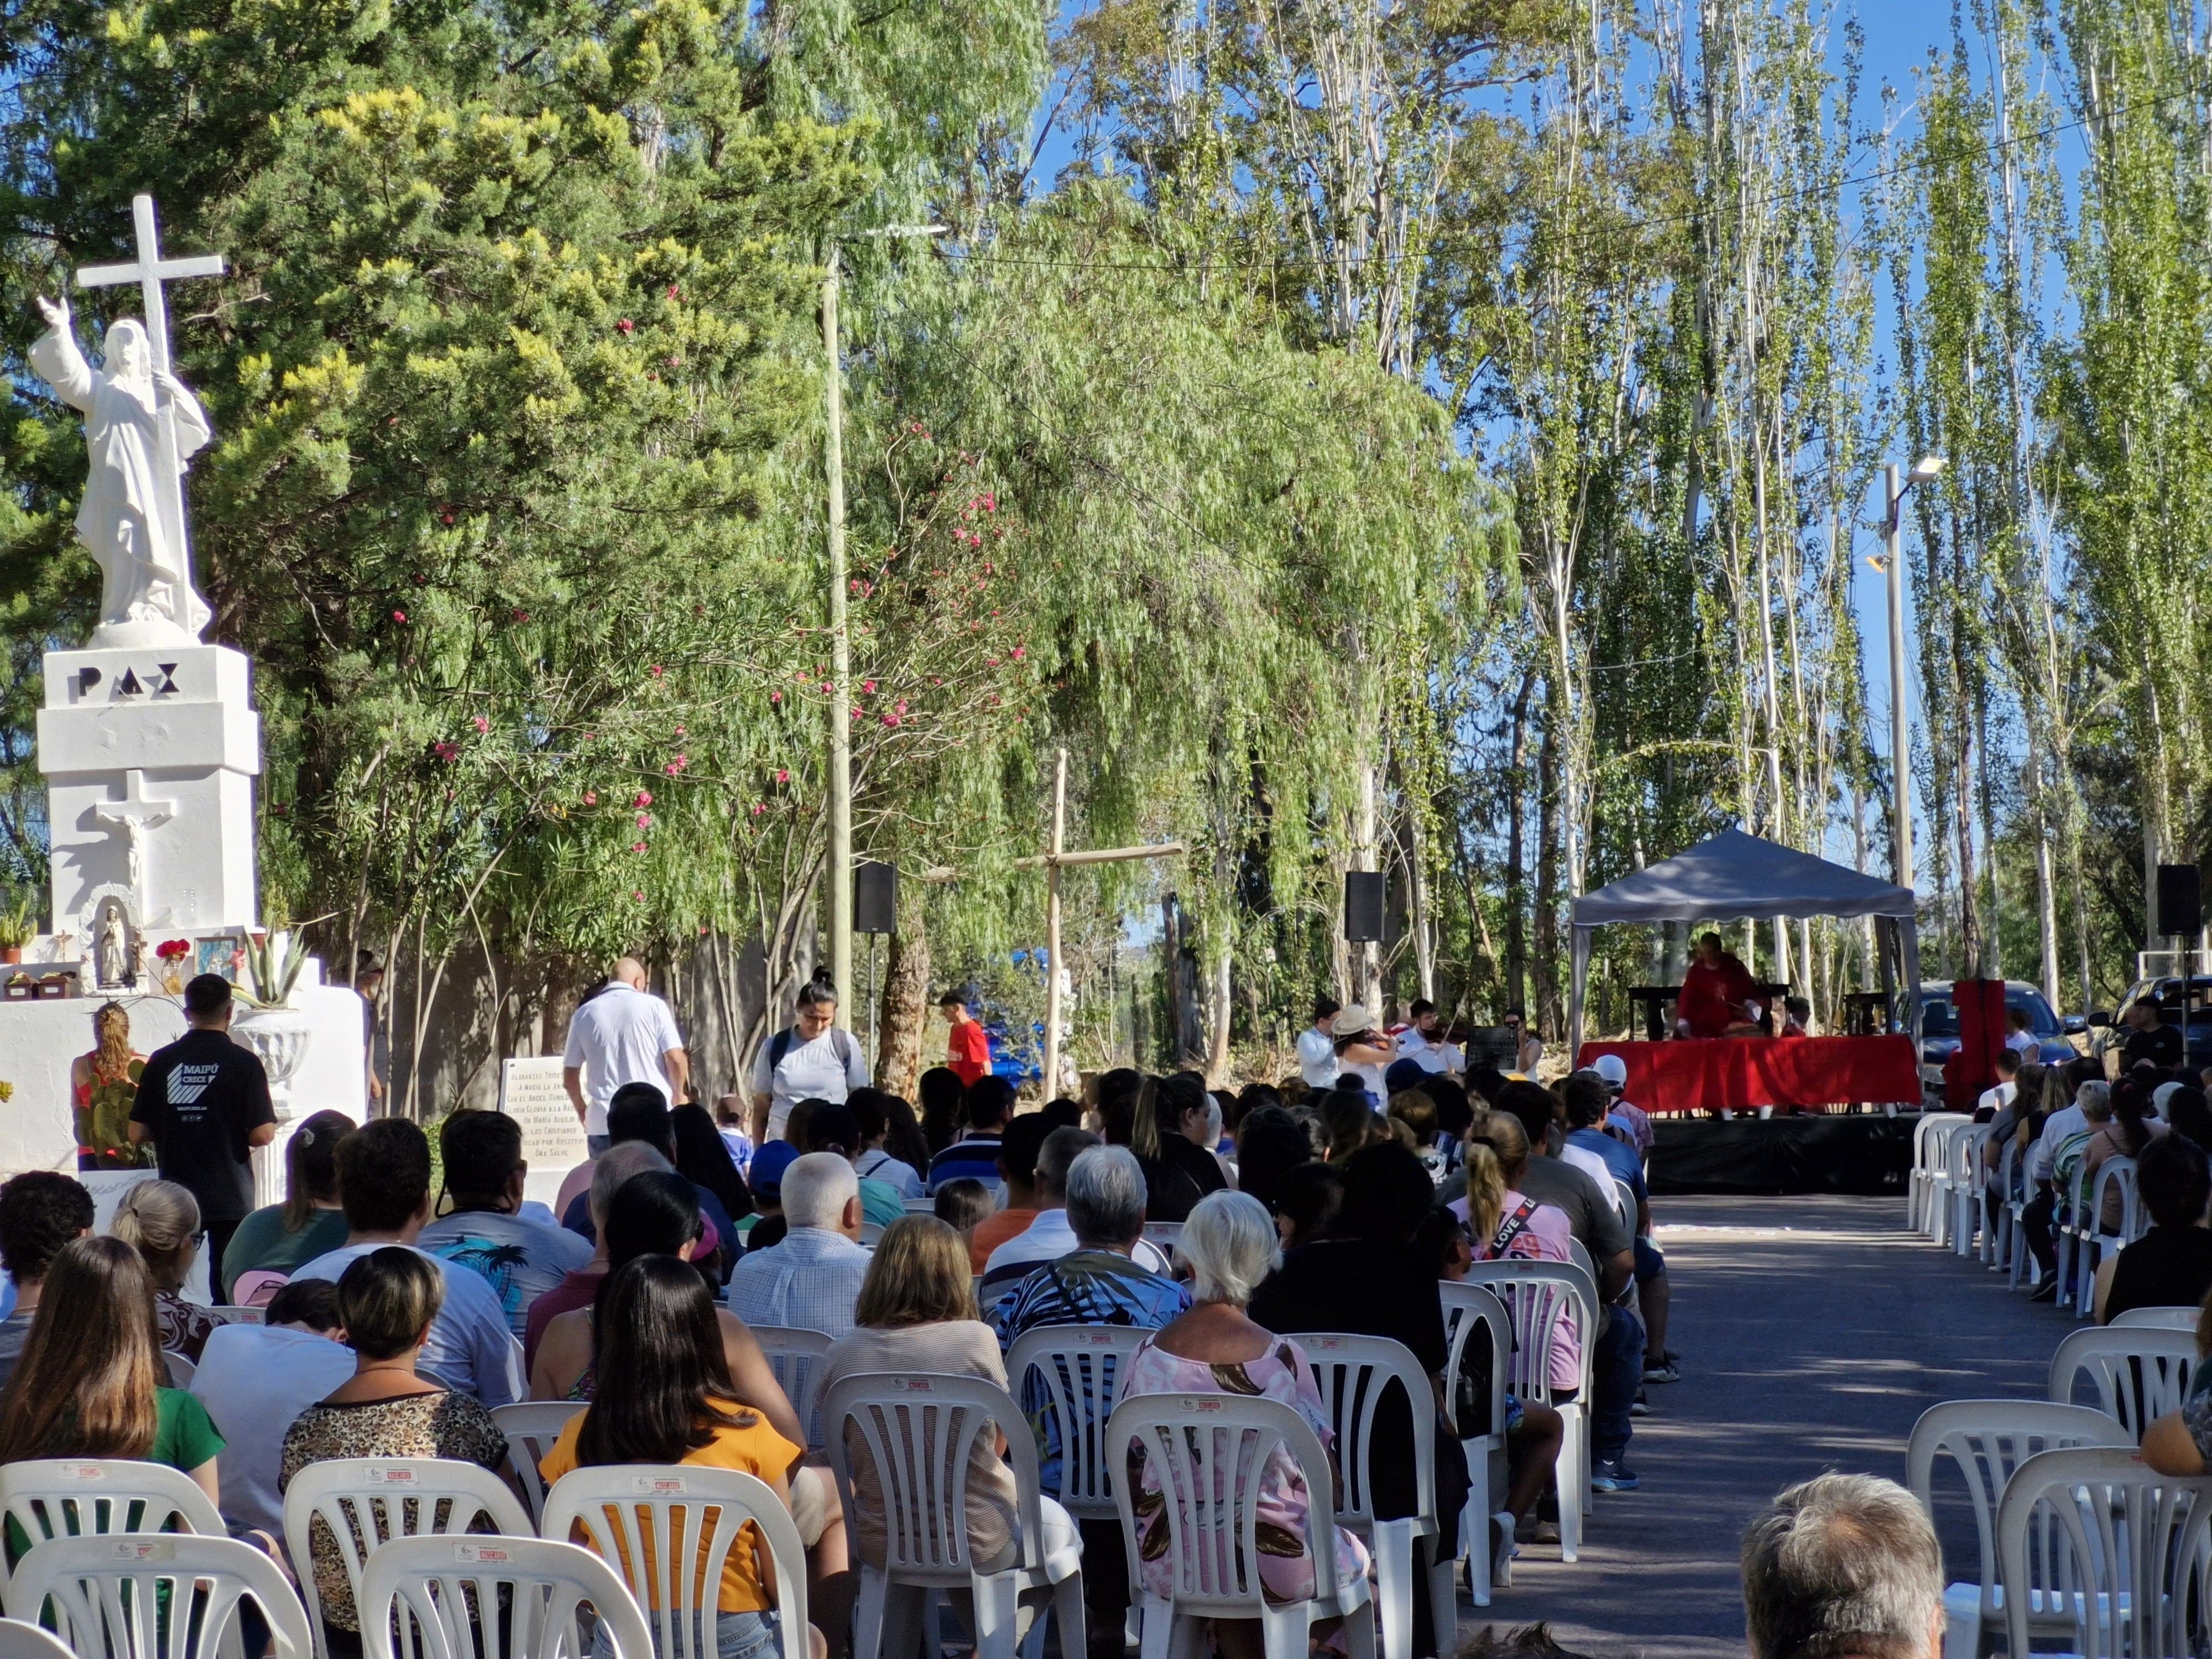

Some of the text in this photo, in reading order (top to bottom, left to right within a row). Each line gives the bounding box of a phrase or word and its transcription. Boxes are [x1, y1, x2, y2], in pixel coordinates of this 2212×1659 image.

[79, 663, 180, 696] PAX
[184, 1063, 219, 1074] MAIPÚ
[1493, 1218, 1520, 1249] LOVE
